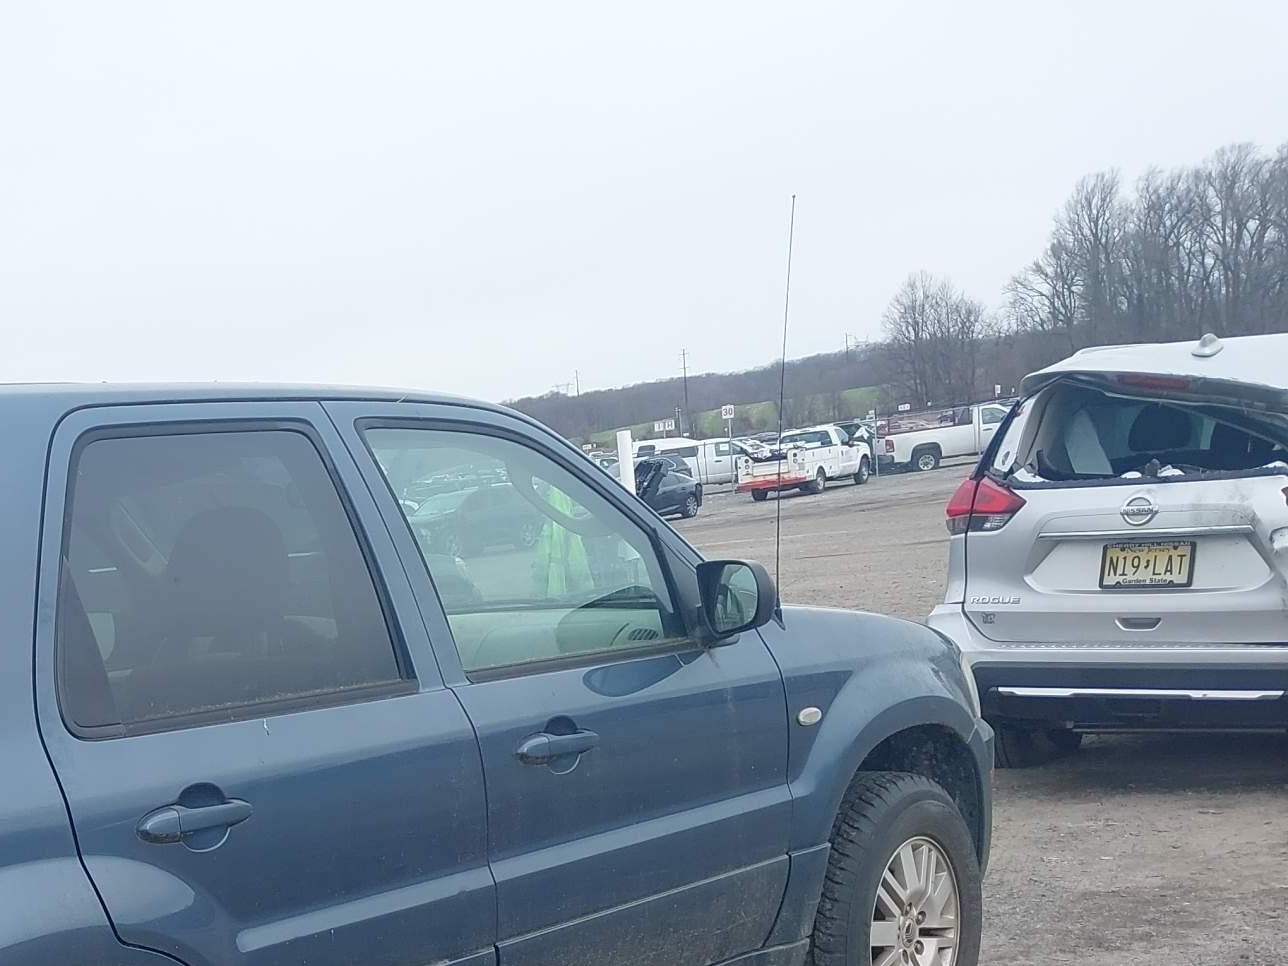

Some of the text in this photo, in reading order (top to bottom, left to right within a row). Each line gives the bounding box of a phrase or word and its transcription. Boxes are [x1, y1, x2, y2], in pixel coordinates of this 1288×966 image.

[722, 407, 733, 417] 30
[1107, 554, 1187, 577] N19 LAT
[970, 596, 1021, 605] ROGUE
